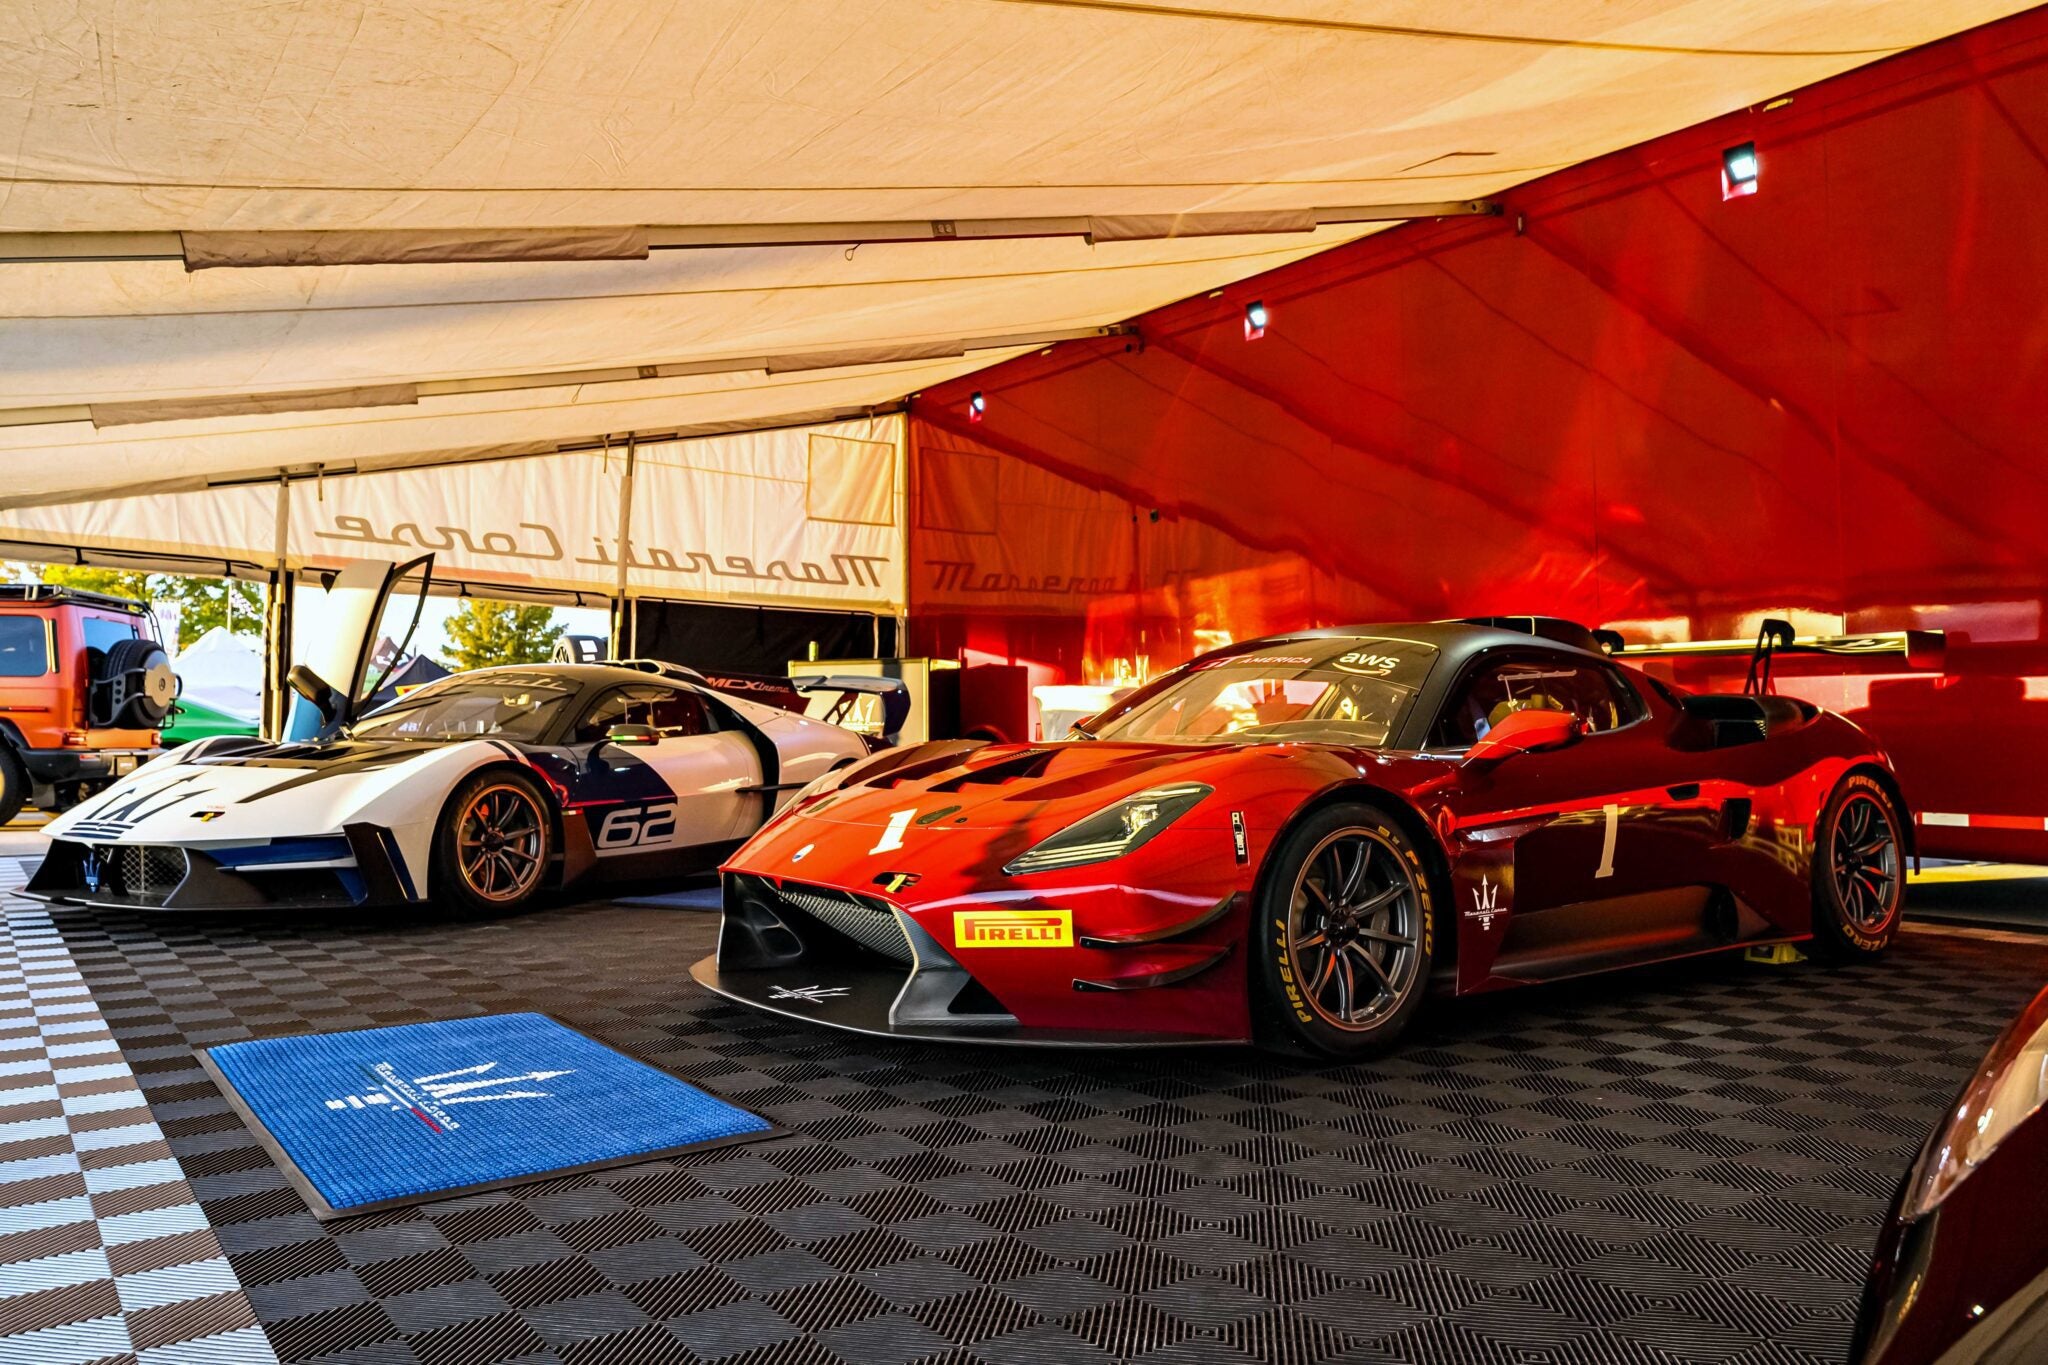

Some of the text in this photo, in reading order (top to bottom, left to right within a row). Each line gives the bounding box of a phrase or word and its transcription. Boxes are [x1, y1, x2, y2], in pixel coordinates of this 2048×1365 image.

[1238, 656, 1313, 665] AMERICA
[1339, 651, 1400, 670] aws
[1848, 775, 1893, 809] PIRELLI
[597, 803, 678, 849] 62
[868, 808, 918, 856] 1
[1594, 803, 1618, 878] 1
[964, 917, 1062, 941] PIRELLI
[1275, 918, 1313, 1023] PIRELLI
